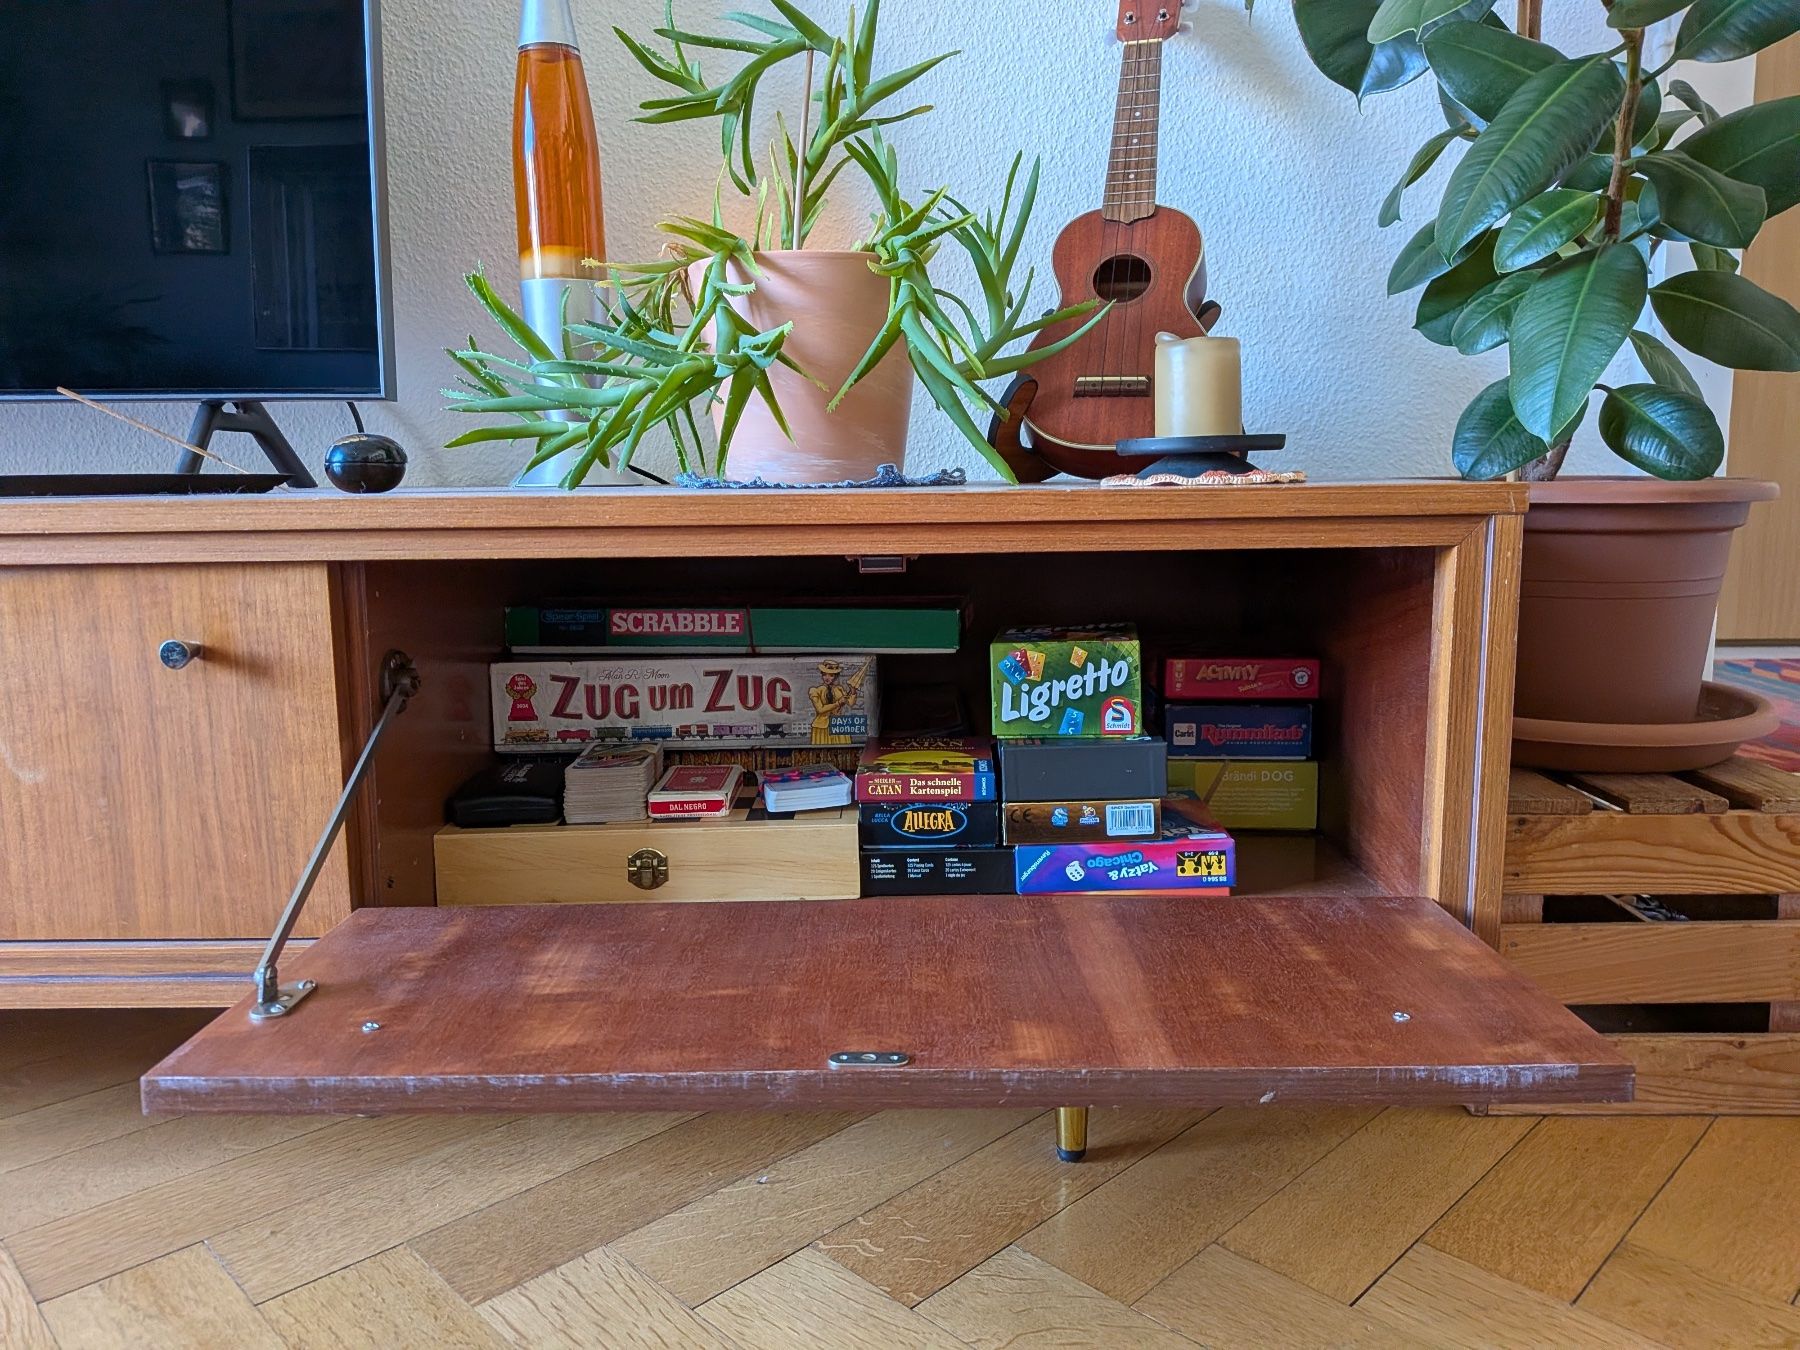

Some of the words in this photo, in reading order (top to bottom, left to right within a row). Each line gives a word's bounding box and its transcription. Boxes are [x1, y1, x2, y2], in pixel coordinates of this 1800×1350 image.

[612, 612, 740, 633] SCRABBLE
[643, 667, 671, 680] Moon
[1001, 657, 1129, 722] Ligretto
[831, 717, 852, 726] DAYS
[854, 717, 866, 725] OF
[1200, 723, 1304, 746] Rummikub
[909, 778, 926, 786] Das
[927, 777, 962, 786] schnelle
[1261, 770, 1294, 782] DOG
[868, 784, 902, 795] CATAN
[909, 786, 962, 797] Kartenspiel
[669, 803, 683, 811] DAL
[683, 803, 707, 811] NEGRO
[902, 810, 956, 832] ALLEGRA
[1020, 849, 1051, 882] Ravensburger
[1087, 851, 1143, 868] Chicago
